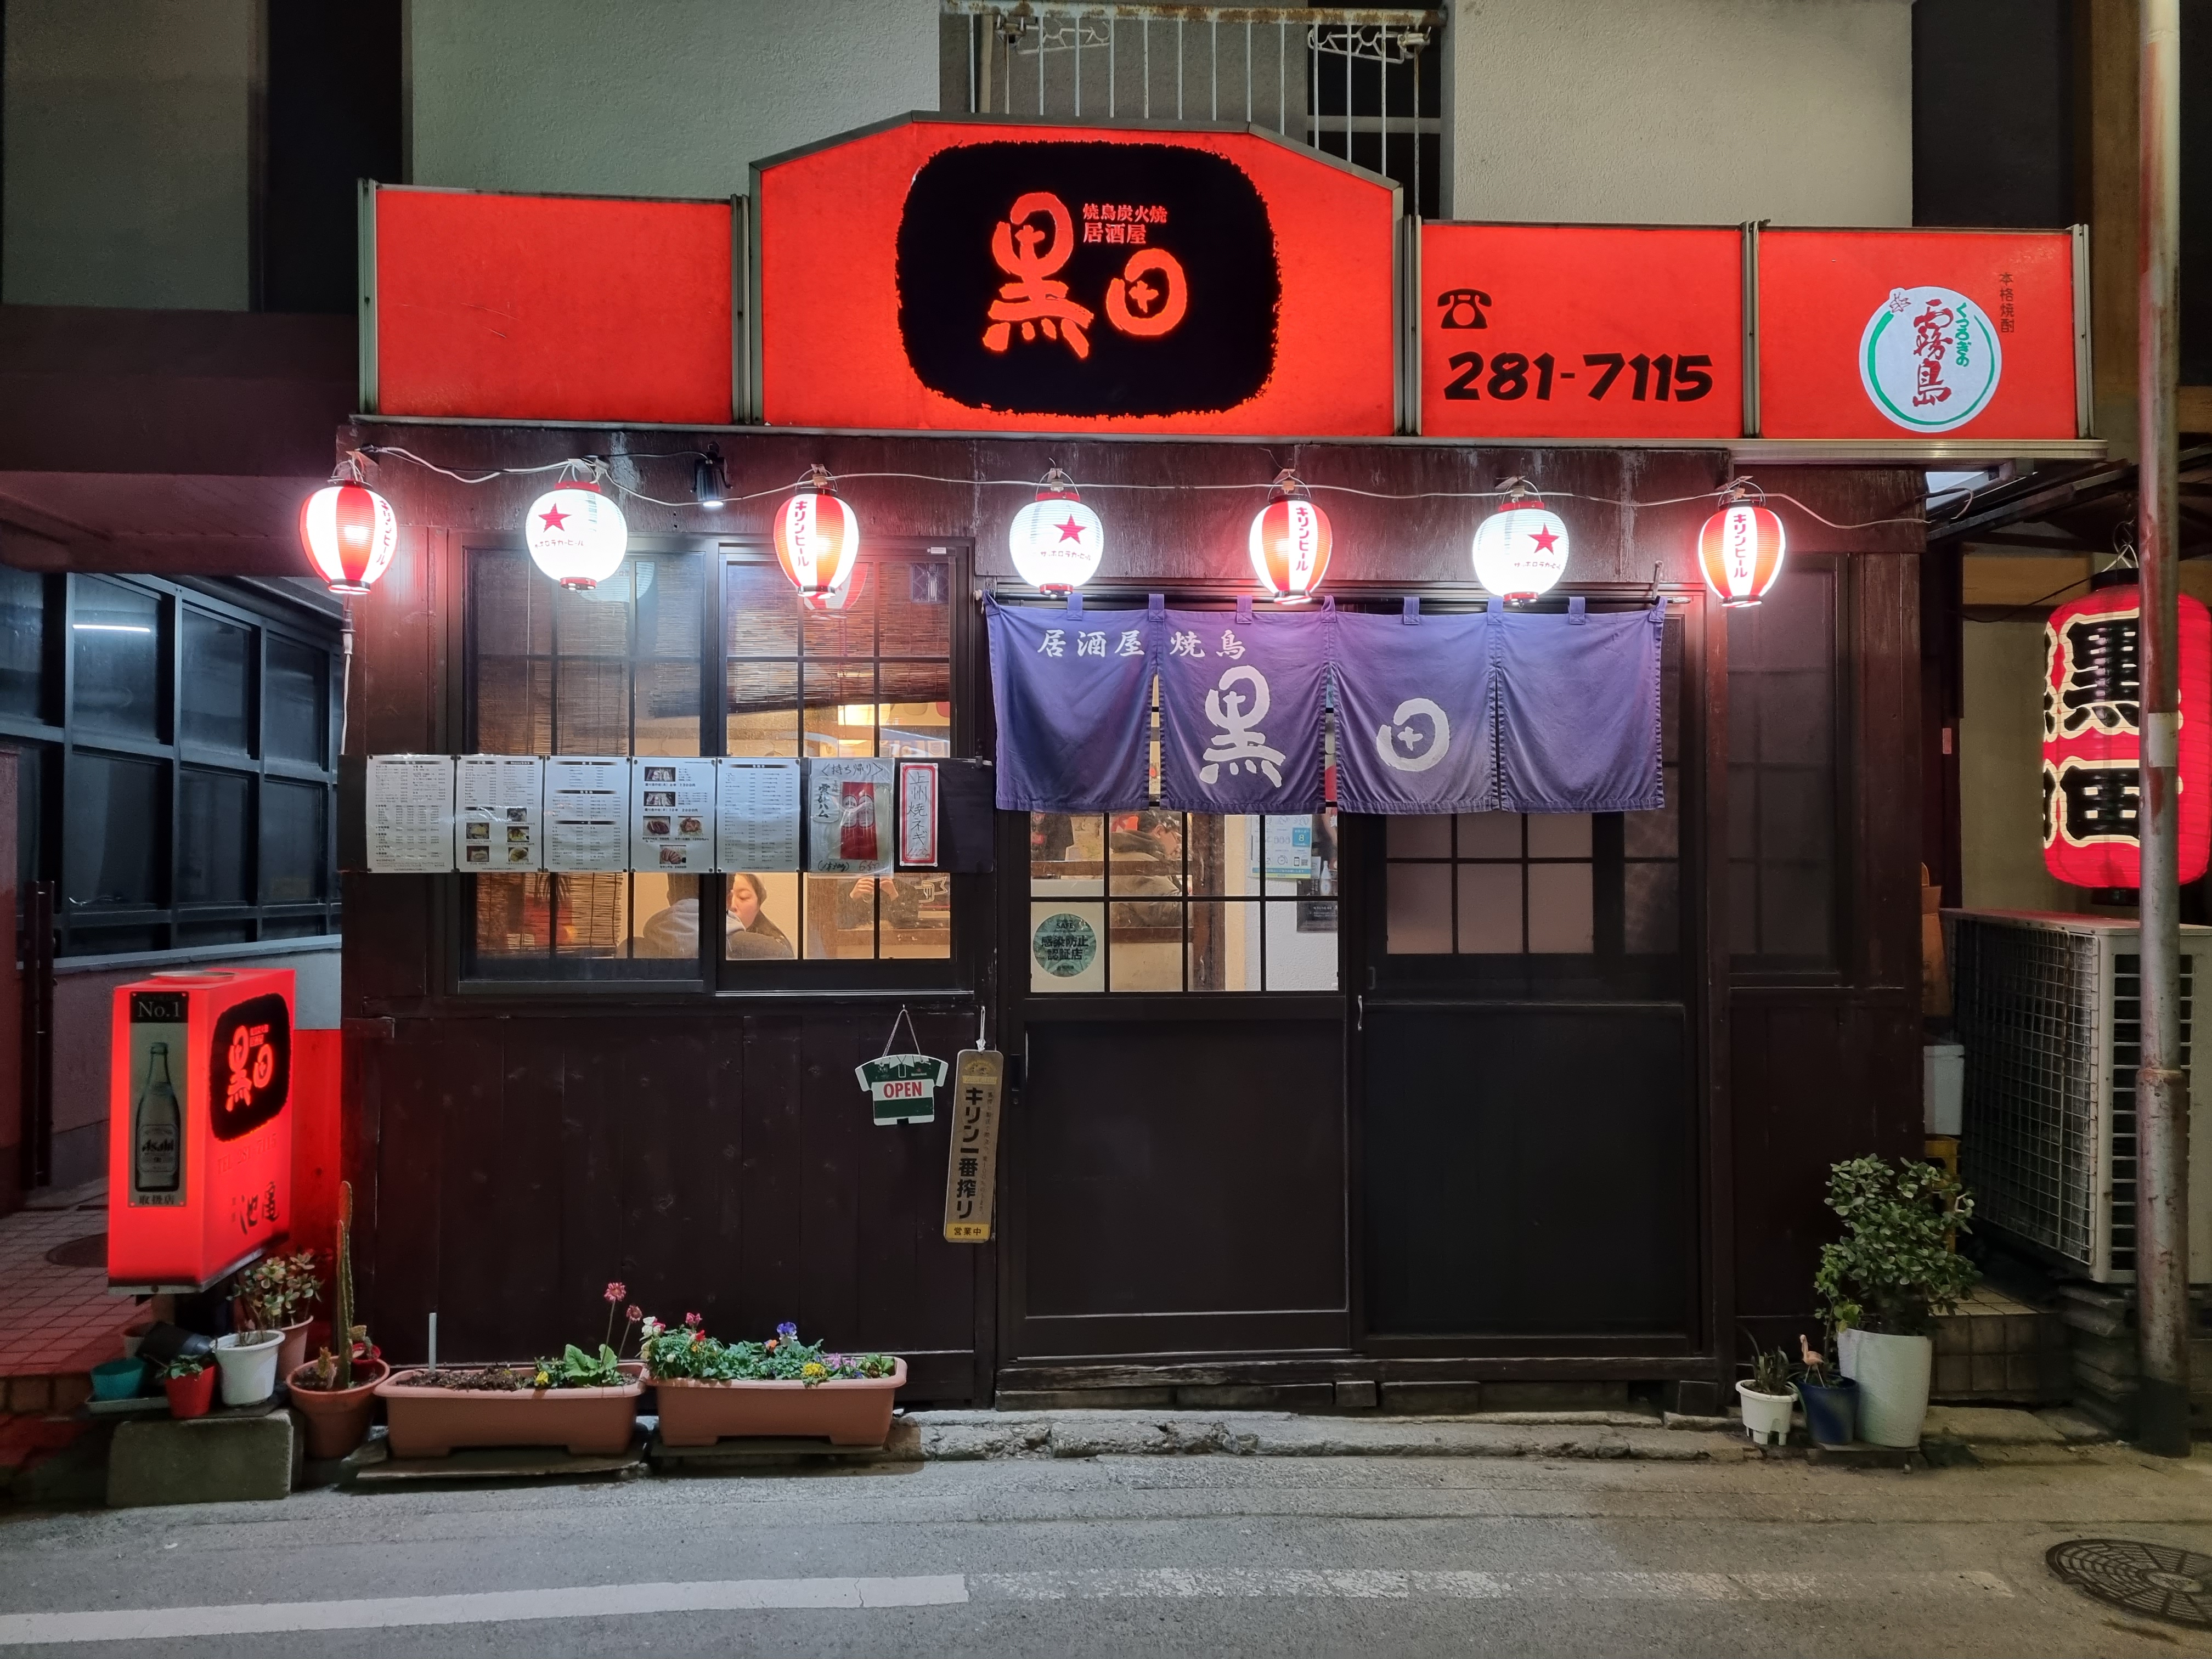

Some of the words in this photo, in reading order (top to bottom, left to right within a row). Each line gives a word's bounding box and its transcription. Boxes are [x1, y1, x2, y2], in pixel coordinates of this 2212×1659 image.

[1082, 203, 1168, 224] 焼鳥炭火焼
[1083, 222, 1147, 245] 居酒屋
[983, 192, 1187, 358] 黒田
[1999, 272, 2015, 334] 本格焼酎
[1912, 298, 1954, 407] 霧島
[1444, 351, 1713, 403] 281-7115
[1037, 629, 1147, 658] 居酒屋
[1169, 629, 1247, 659] 焼鳥
[906, 771, 930, 845] 上州焼ネギ
[1041, 935, 1089, 947] 感染防止
[1047, 947, 1083, 961] 認証店
[138, 1001, 180, 1018] No.1
[883, 1081, 923, 1099] OPEN
[956, 1087, 984, 1220] キリン一番搾り
[953, 1227, 982, 1236] 営業中
